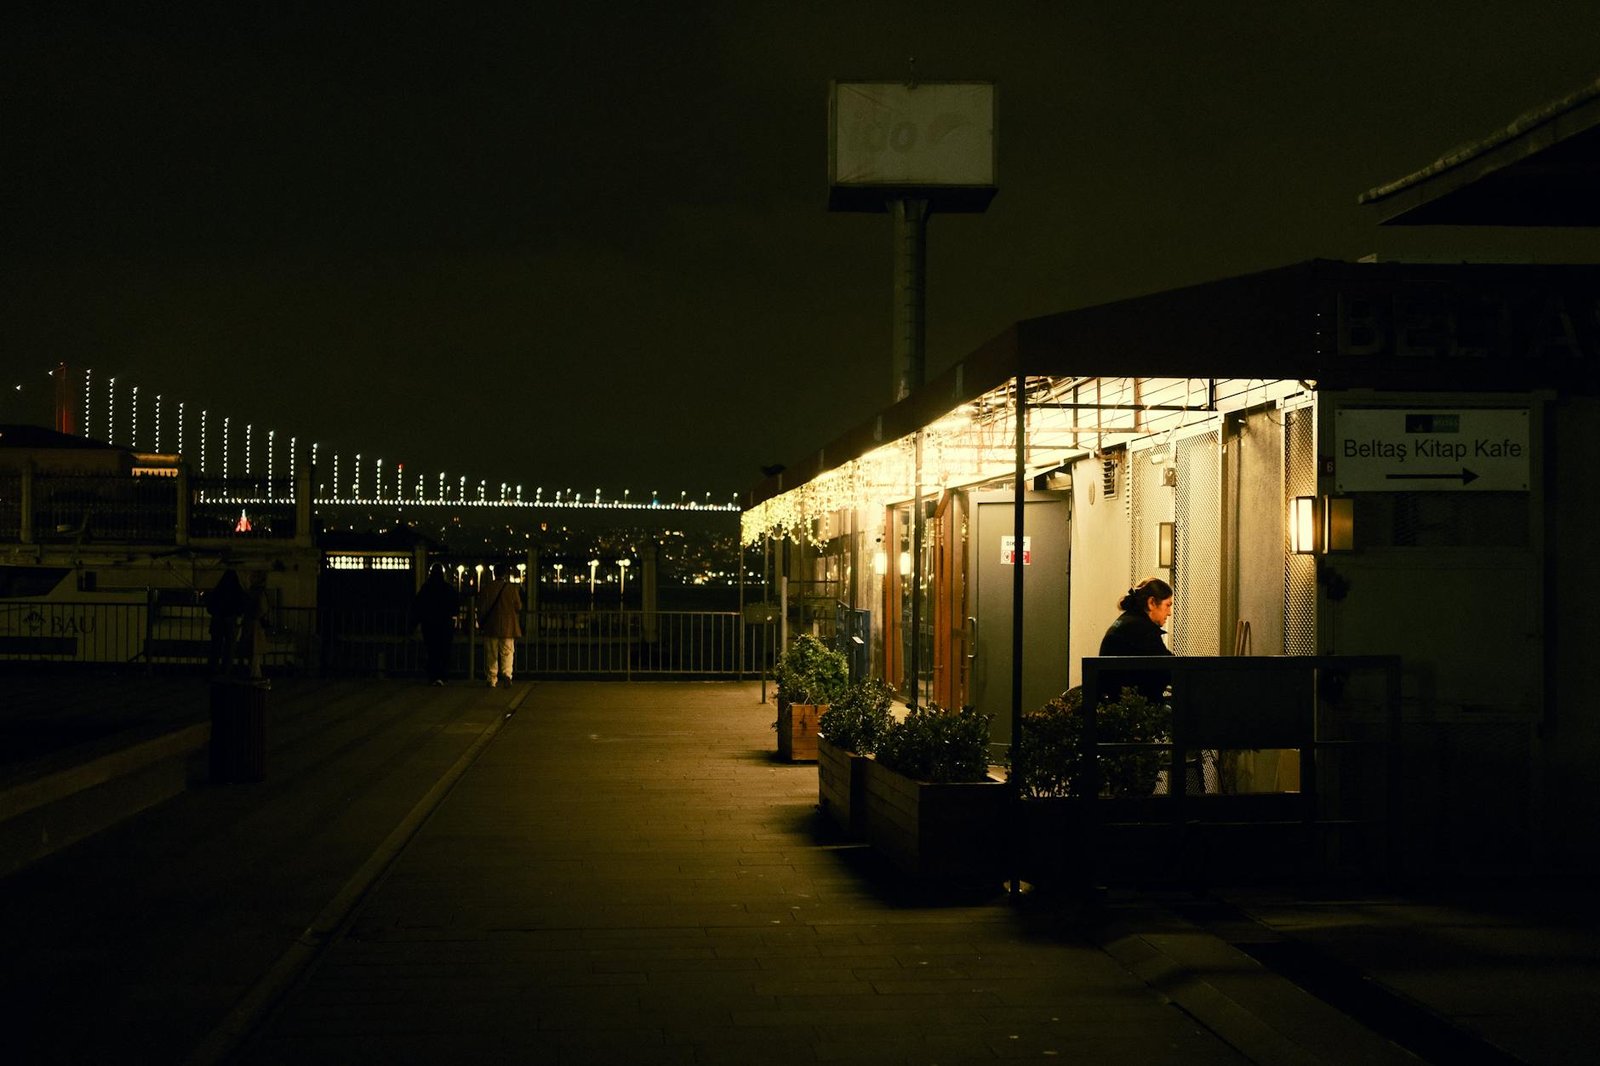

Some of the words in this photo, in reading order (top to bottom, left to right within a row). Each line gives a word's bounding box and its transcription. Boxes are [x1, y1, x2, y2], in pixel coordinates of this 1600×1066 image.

[1337, 291, 1600, 358] BELTA
[1343, 439, 1407, 463] Beltaş
[1415, 439, 1467, 462] Kitap
[1475, 439, 1522, 457] Kafe
